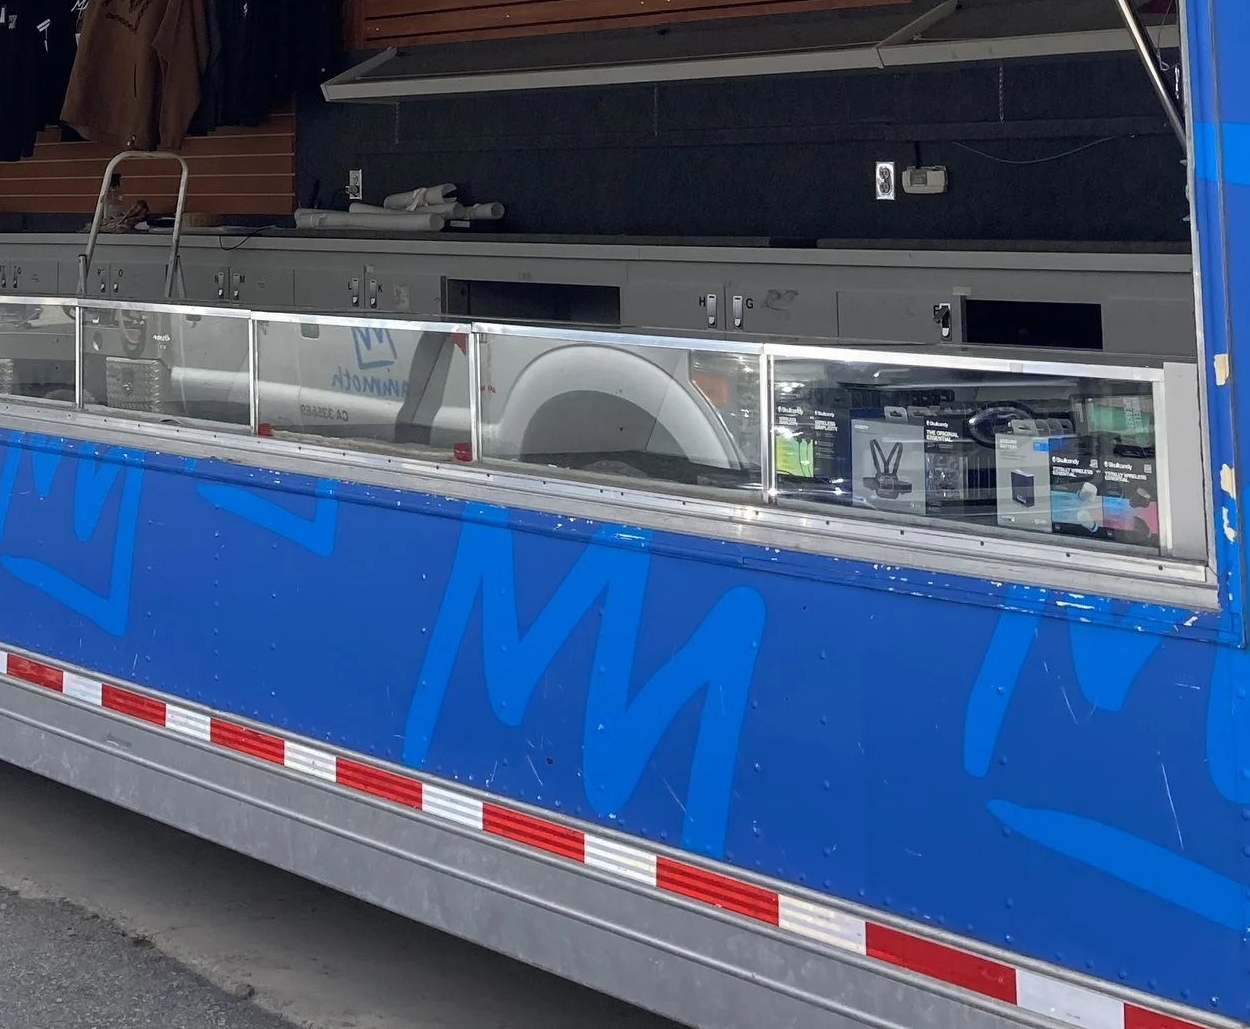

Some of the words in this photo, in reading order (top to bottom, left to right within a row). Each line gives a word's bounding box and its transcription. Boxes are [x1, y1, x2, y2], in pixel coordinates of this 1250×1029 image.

[377, 284, 383, 292] K
[699, 296, 706, 307] H
[745, 297, 754, 309] G
